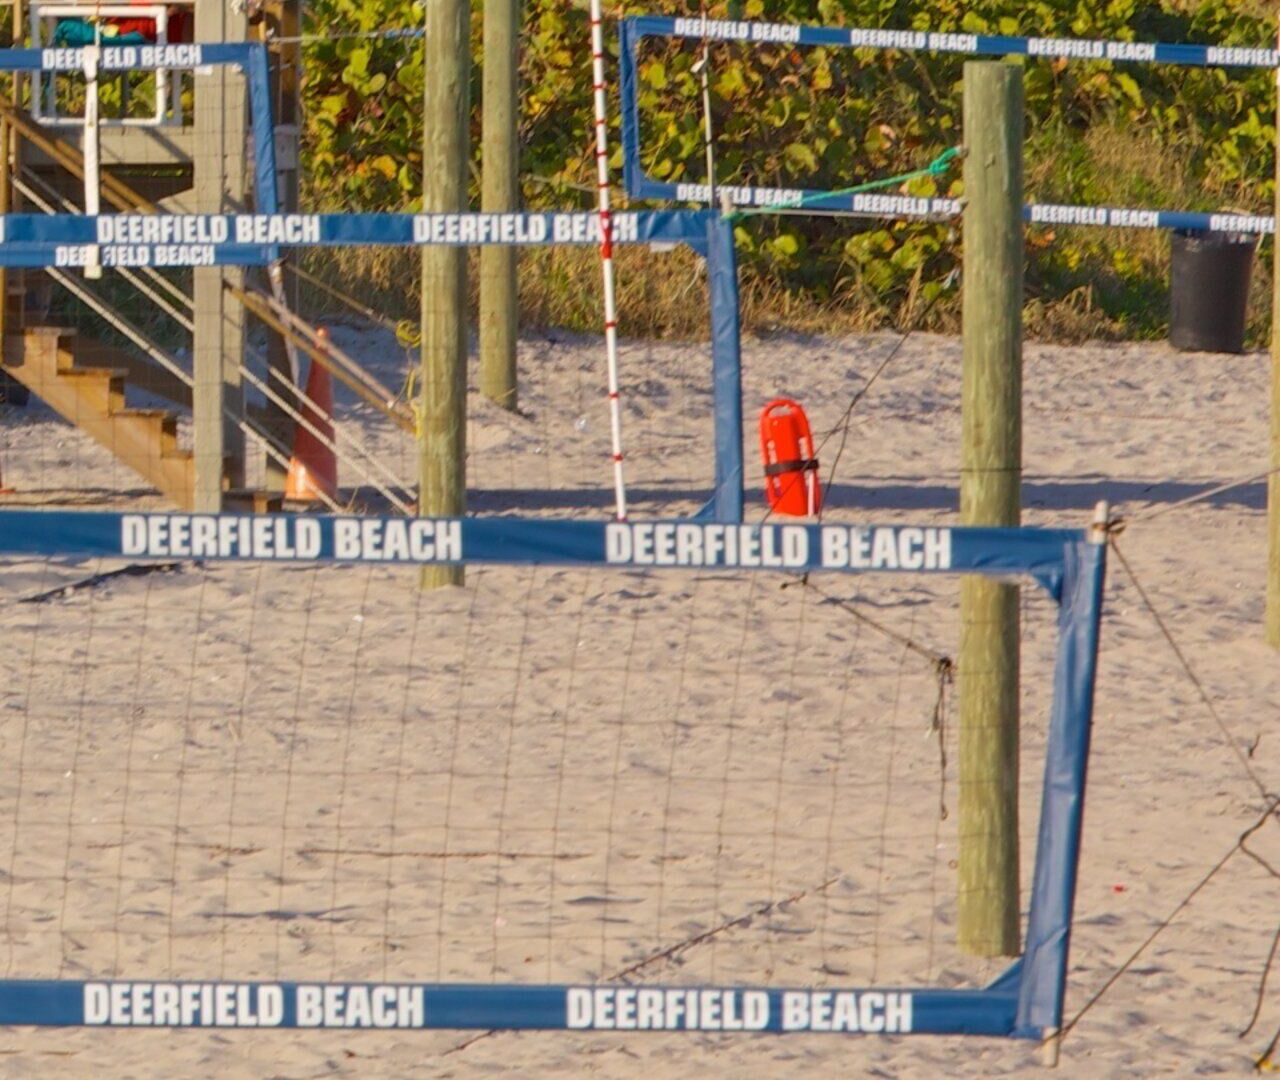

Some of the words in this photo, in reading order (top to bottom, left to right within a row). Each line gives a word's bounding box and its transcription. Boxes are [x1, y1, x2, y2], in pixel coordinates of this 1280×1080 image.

[751, 22, 800, 43] BEACH
[850, 29, 926, 49] DEERFIELD
[928, 32, 977, 52] BEACH
[42, 46, 138, 71] DEERELD
[140, 44, 202, 70] BEACH
[1027, 38, 1104, 58] DEERFIELD
[1106, 41, 1155, 61] BEACH
[754, 187, 803, 207] BEACH
[853, 194, 929, 215] DEERFIELD
[931, 198, 962, 216] BEA
[1030, 204, 1108, 225] DEERFIELD
[1110, 208, 1160, 227] BEACH
[96, 214, 228, 245] DEERFIELD
[235, 214, 321, 244] BEACH
[413, 213, 547, 244] DEERFIELD
[154, 244, 215, 267] BEACH
[121, 515, 321, 559] DEERFIELD
[333, 518, 462, 561] BEACH
[605, 522, 809, 568] DEERFIELD
[821, 526, 952, 570] BEACH
[83, 982, 284, 1027] DEERFIELD
[296, 984, 424, 1028] BEACH
[566, 988, 770, 1031] DEERFIELD
[781, 990, 913, 1033] BEACH
